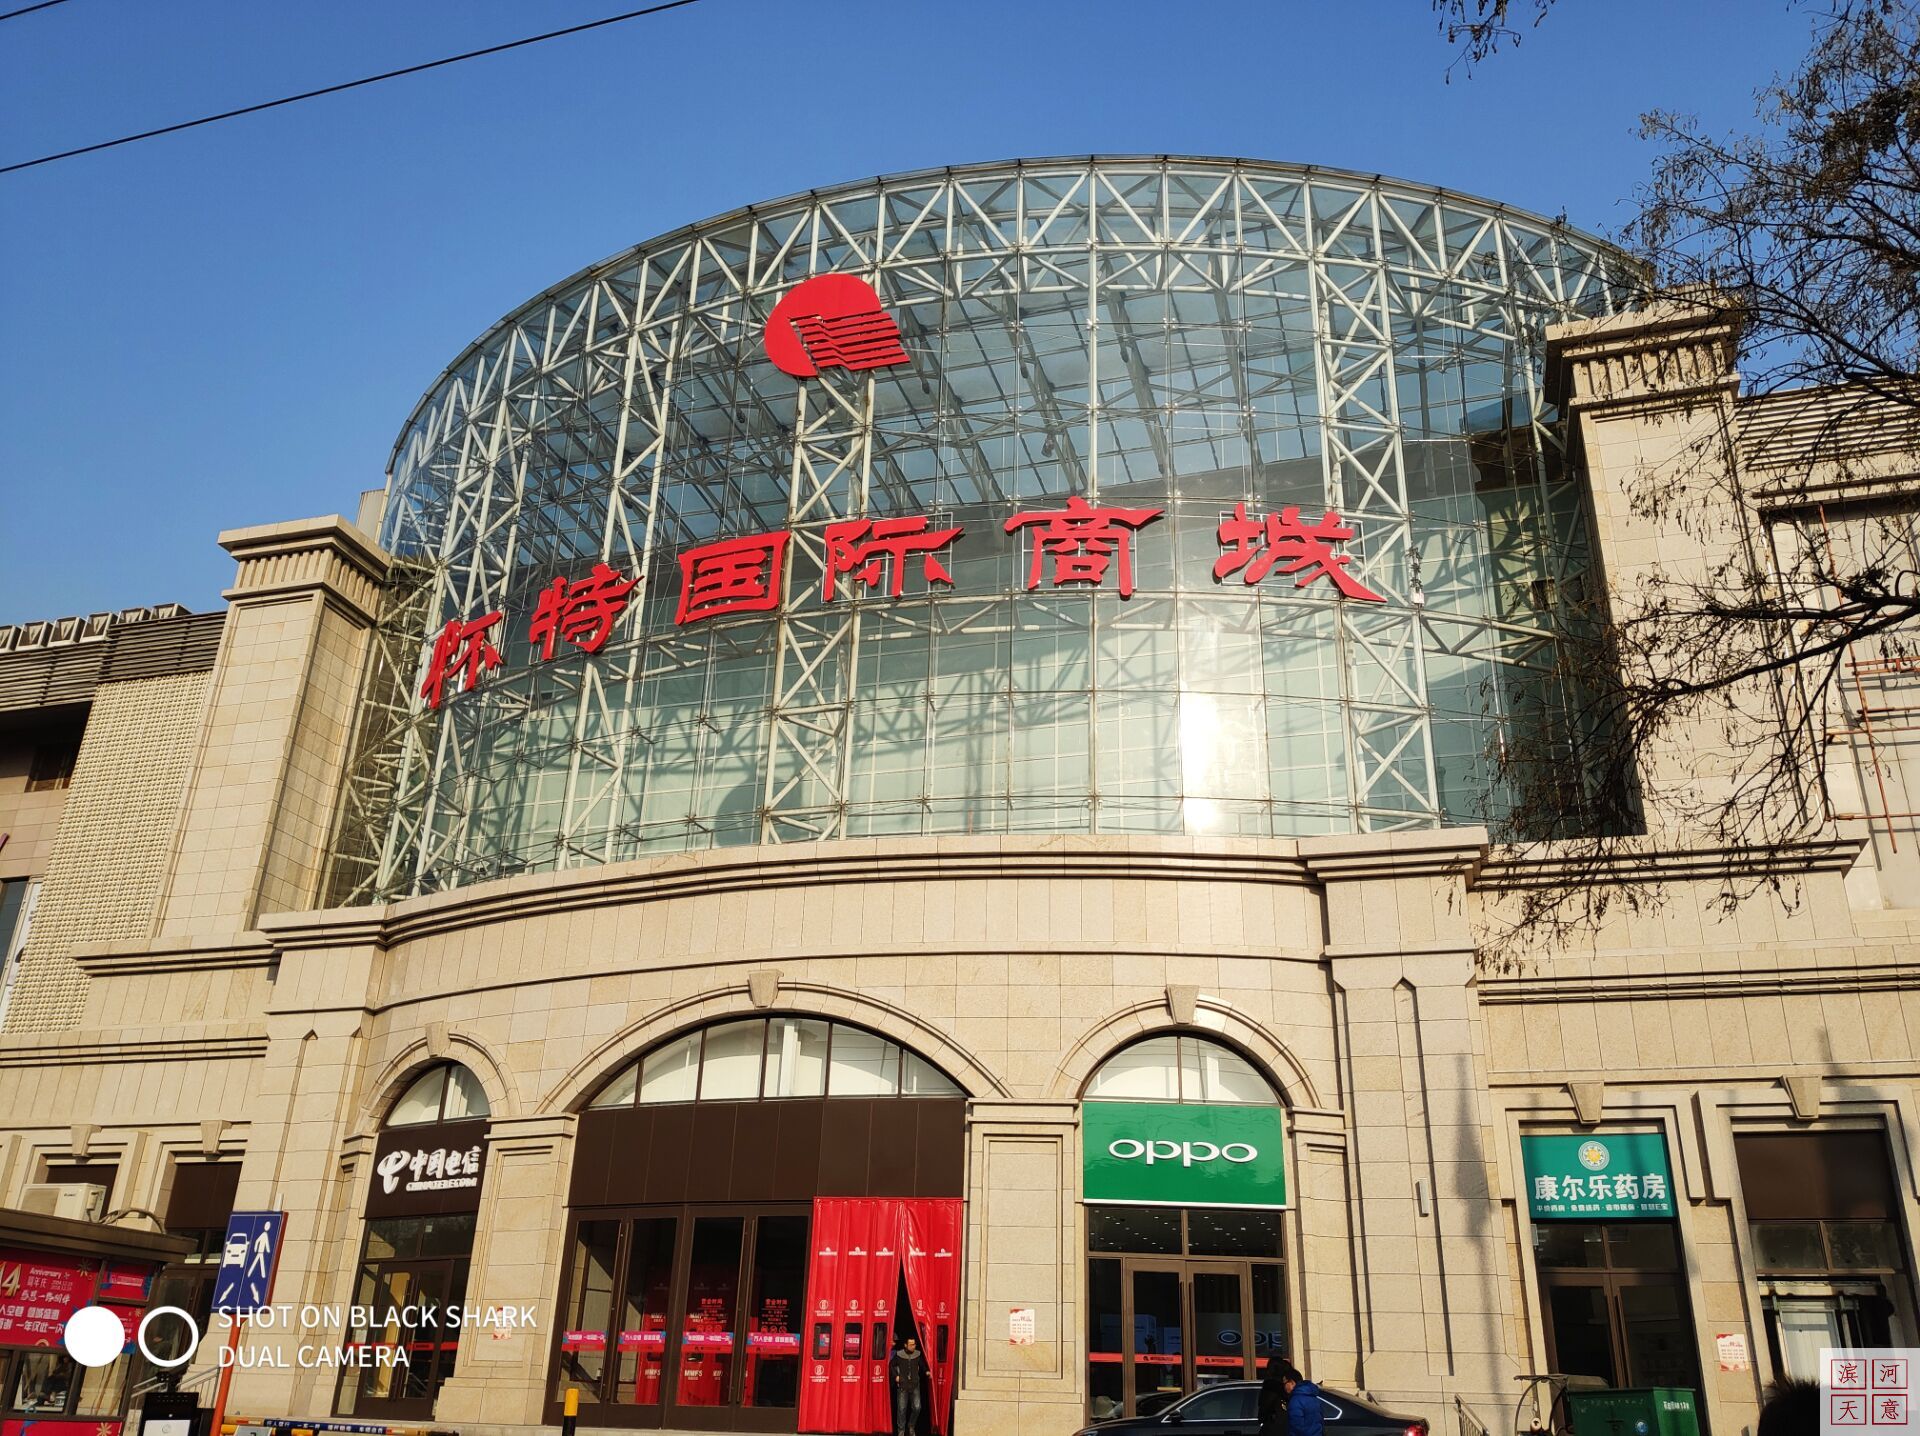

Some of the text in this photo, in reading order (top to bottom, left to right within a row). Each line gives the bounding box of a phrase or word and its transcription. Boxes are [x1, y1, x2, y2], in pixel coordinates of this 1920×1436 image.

[421, 497, 1386, 709] 怀特国际商城
[410, 1145, 481, 1181] 中国电信
[1535, 1174, 1666, 1201] 康尔乐药房
